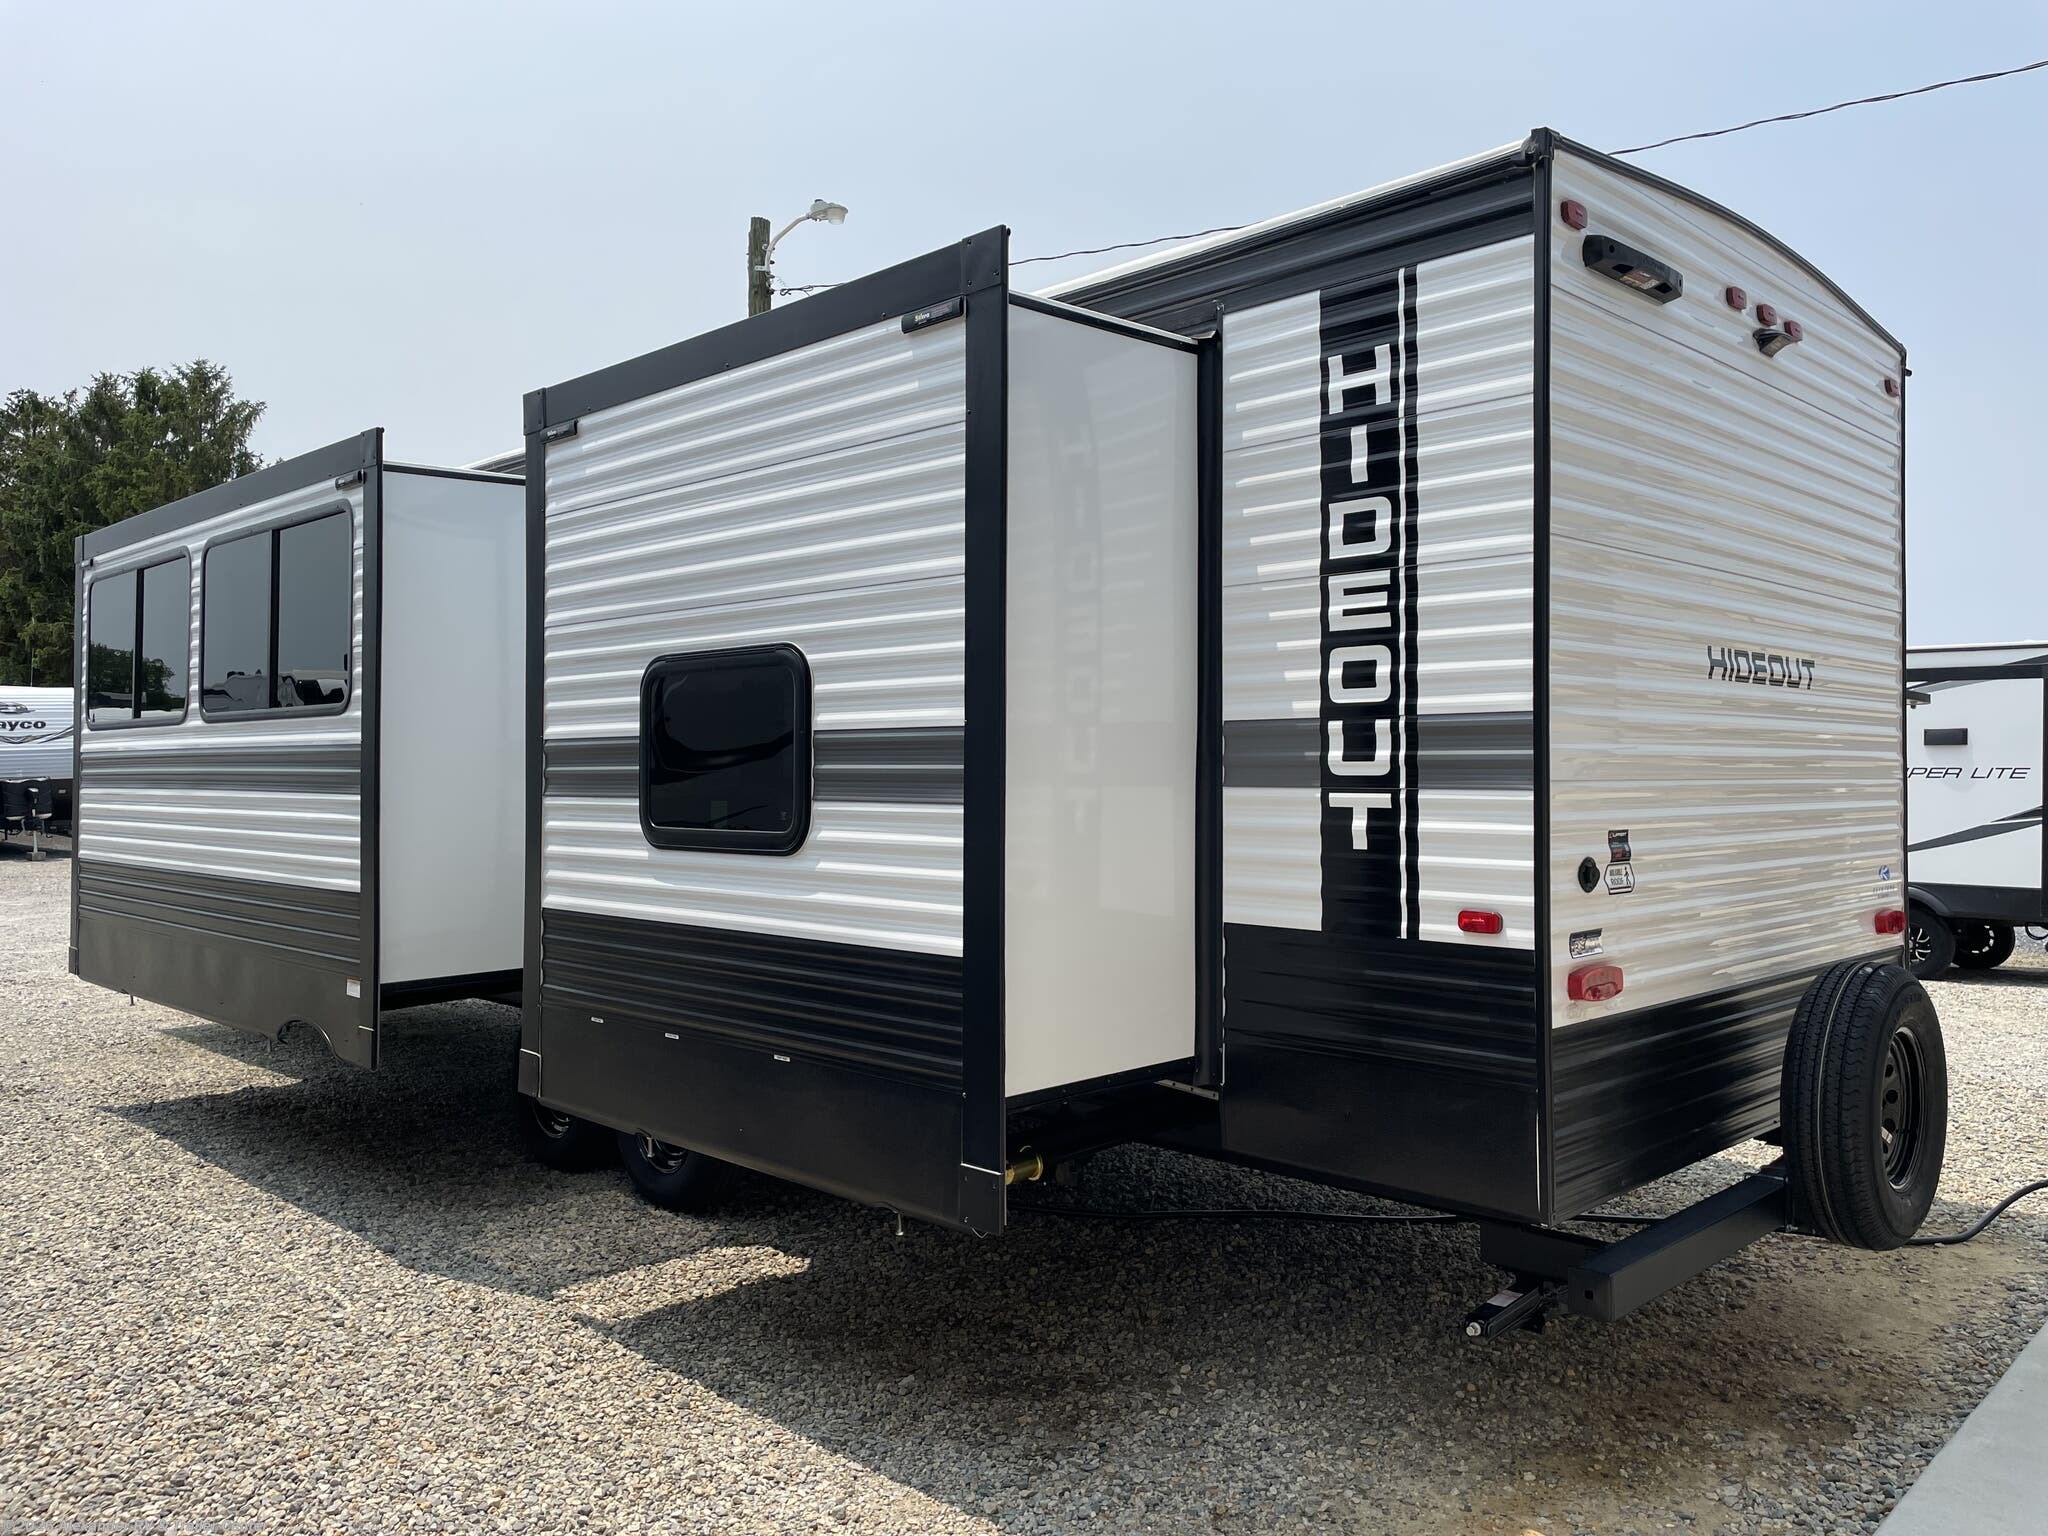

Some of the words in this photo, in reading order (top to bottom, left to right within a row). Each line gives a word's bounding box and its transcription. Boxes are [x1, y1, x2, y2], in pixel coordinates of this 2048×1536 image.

[1327, 343, 1392, 850] HIDEOUT
[1707, 645, 1816, 689] HIDEOUT
[1907, 767, 1963, 779] PER
[1970, 767, 2032, 779] LITE
